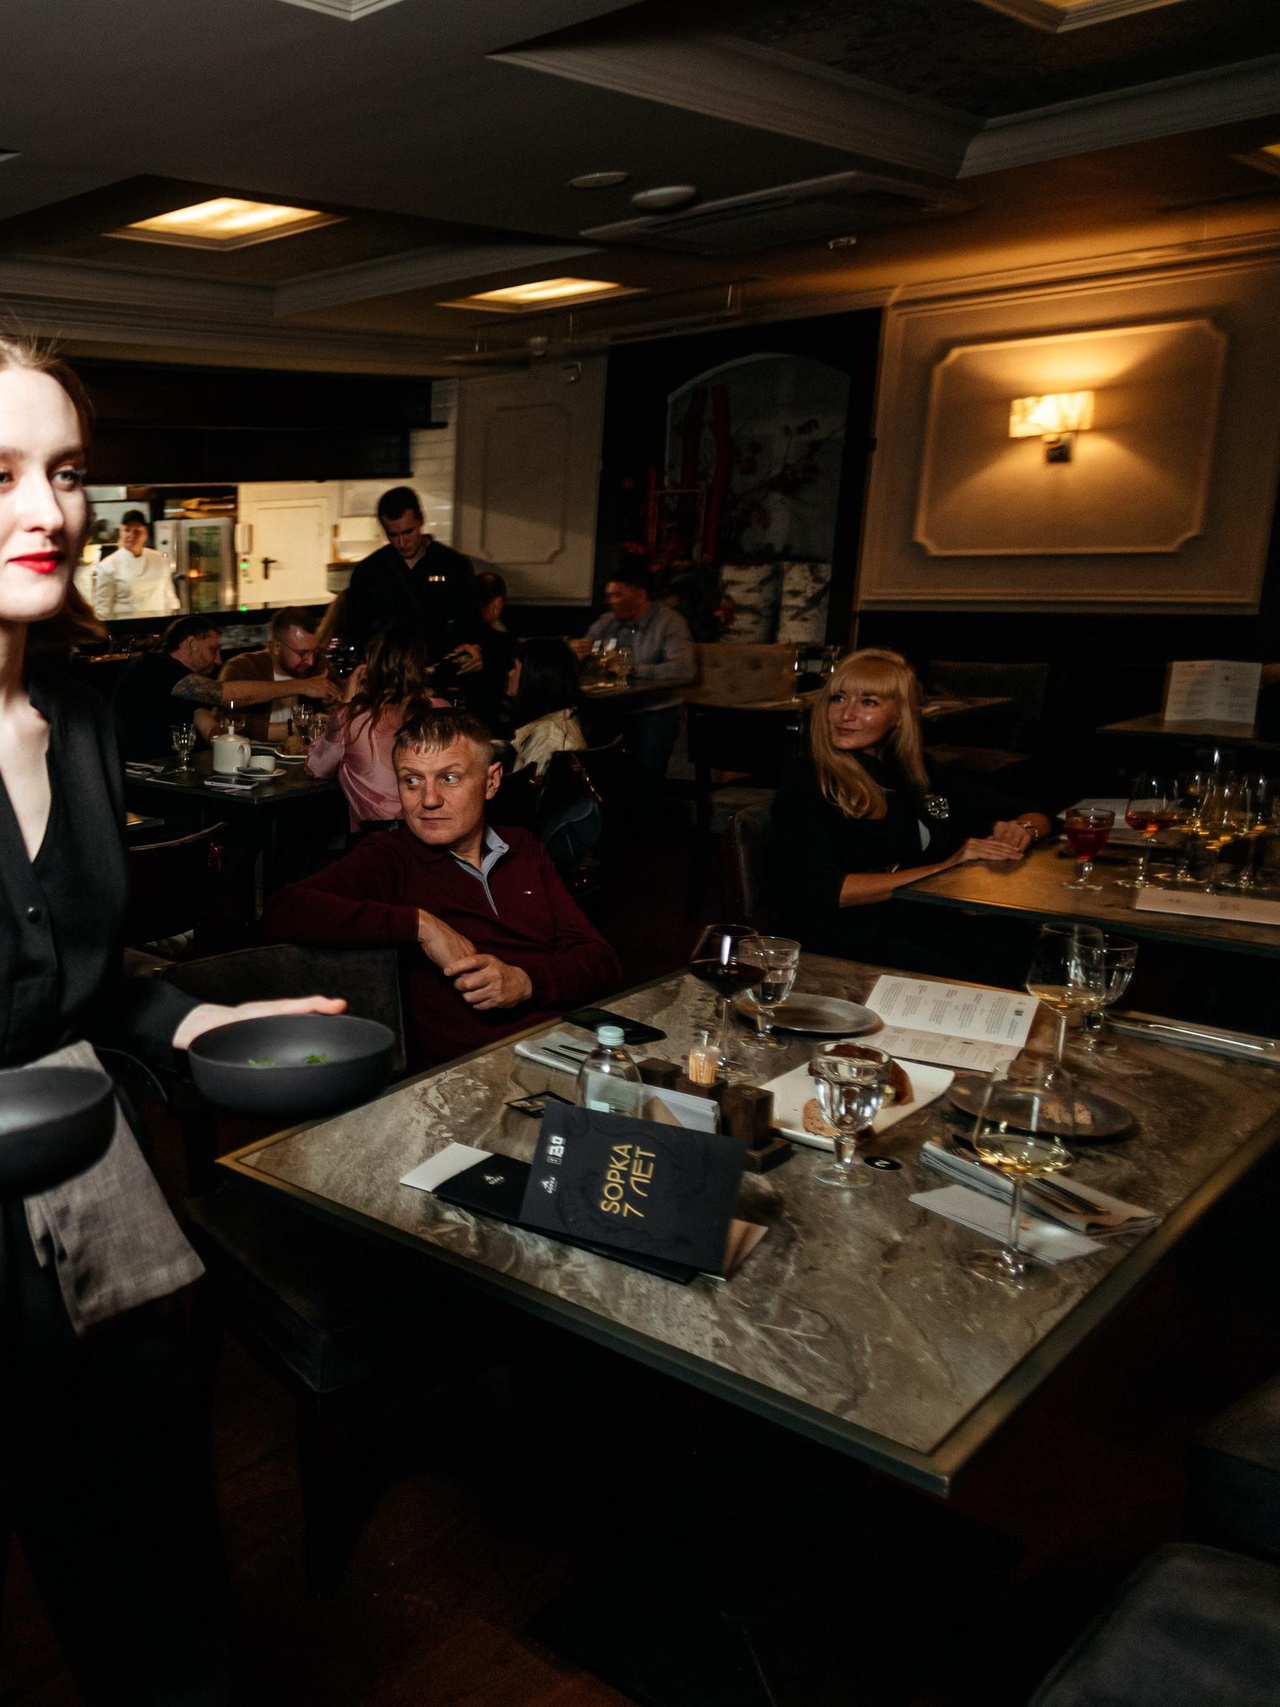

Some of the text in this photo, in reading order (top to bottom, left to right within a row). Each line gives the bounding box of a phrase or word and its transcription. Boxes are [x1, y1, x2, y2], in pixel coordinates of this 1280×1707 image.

[600, 1143, 633, 1215] SOPKA
[622, 1145, 657, 1218] 7 ЛЕТ
